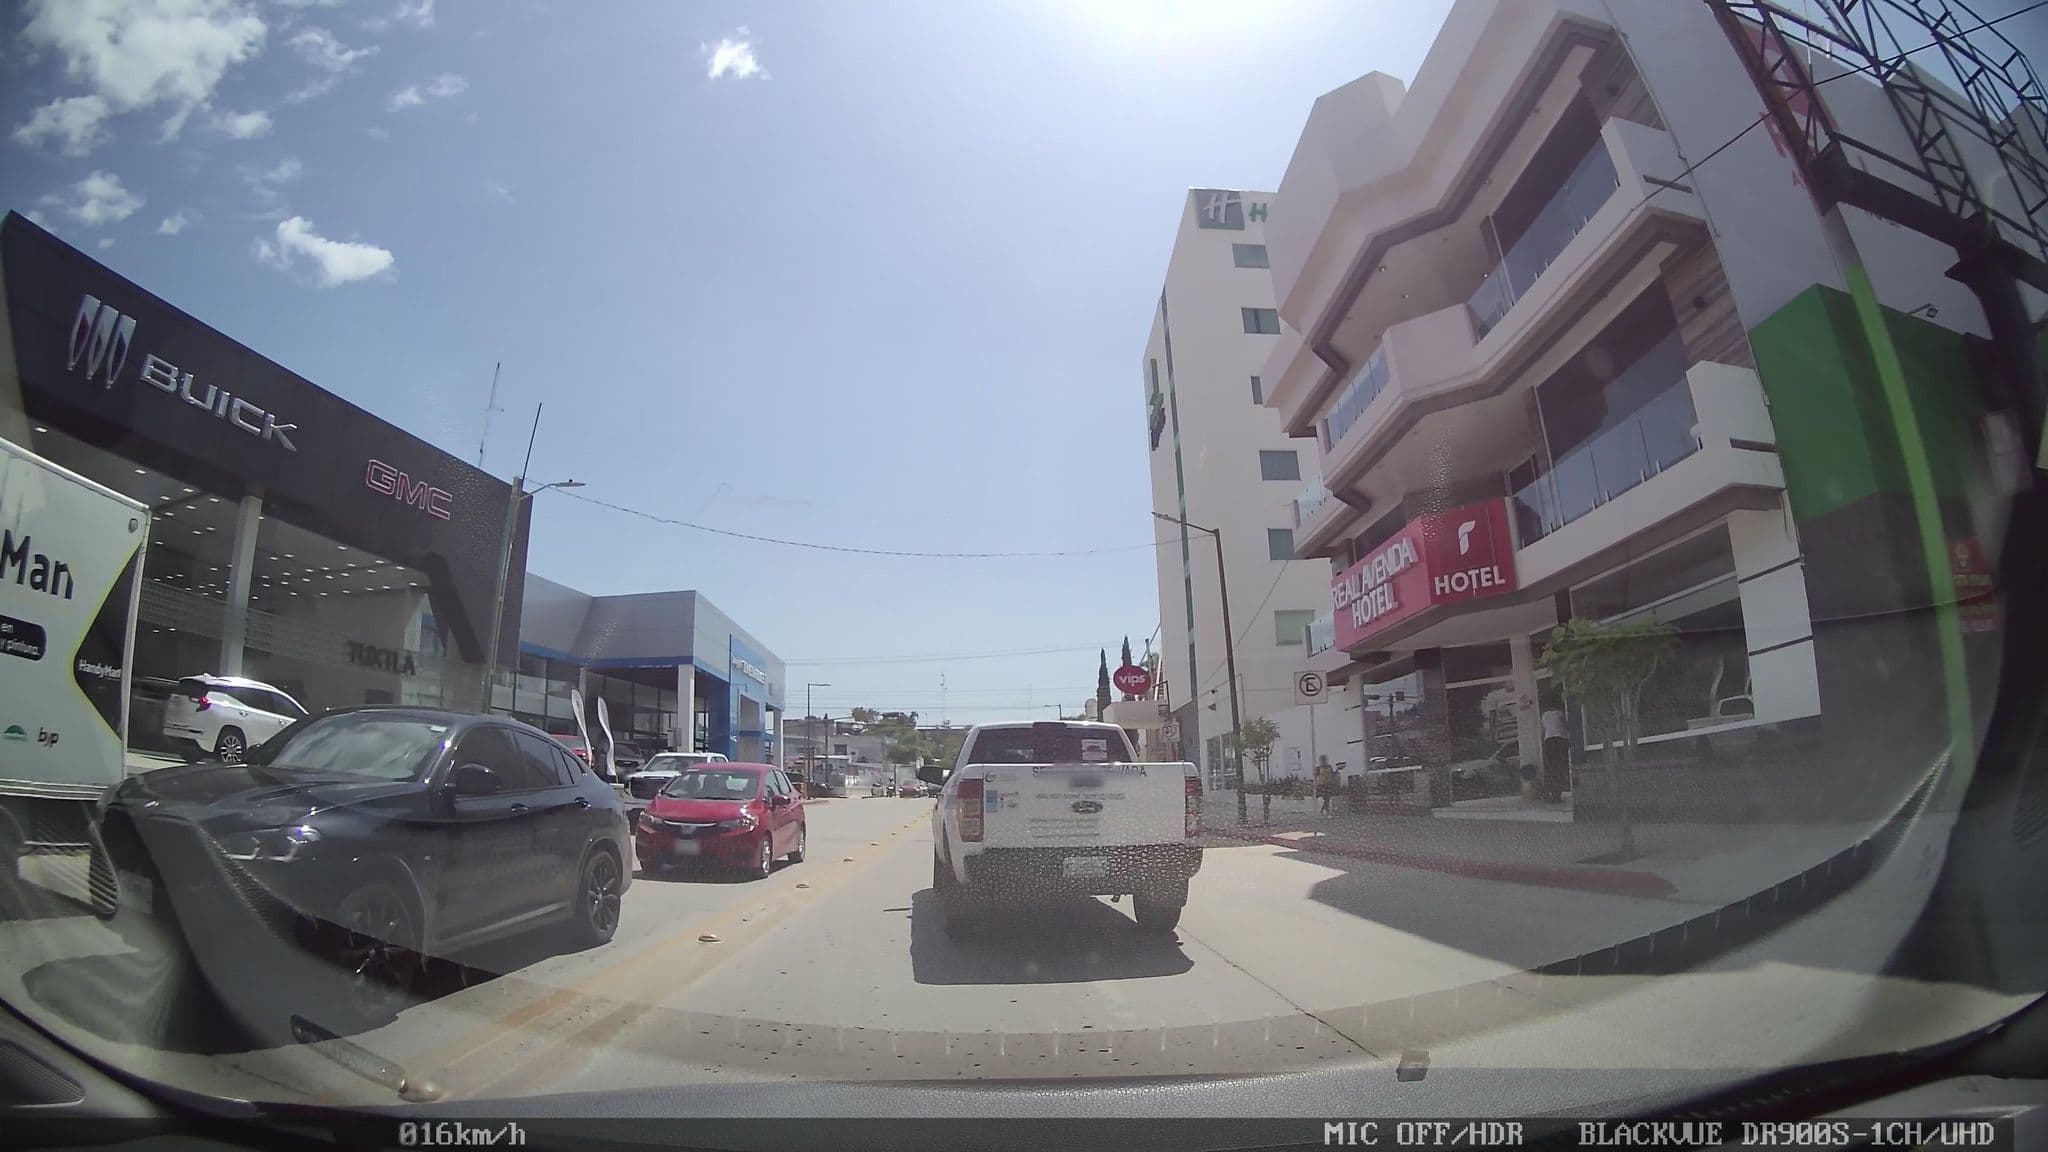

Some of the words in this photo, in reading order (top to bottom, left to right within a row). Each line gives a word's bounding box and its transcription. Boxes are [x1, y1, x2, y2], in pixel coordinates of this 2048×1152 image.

[140, 353, 298, 452] BUICK
[366, 459, 453, 520] GMC
[0, 528, 74, 600] Man
[1434, 565, 1505, 596] HOTEL
[1332, 575, 1363, 610] REAL
[1352, 582, 1393, 629] HOTEL
[1119, 673, 1146, 687] vips
